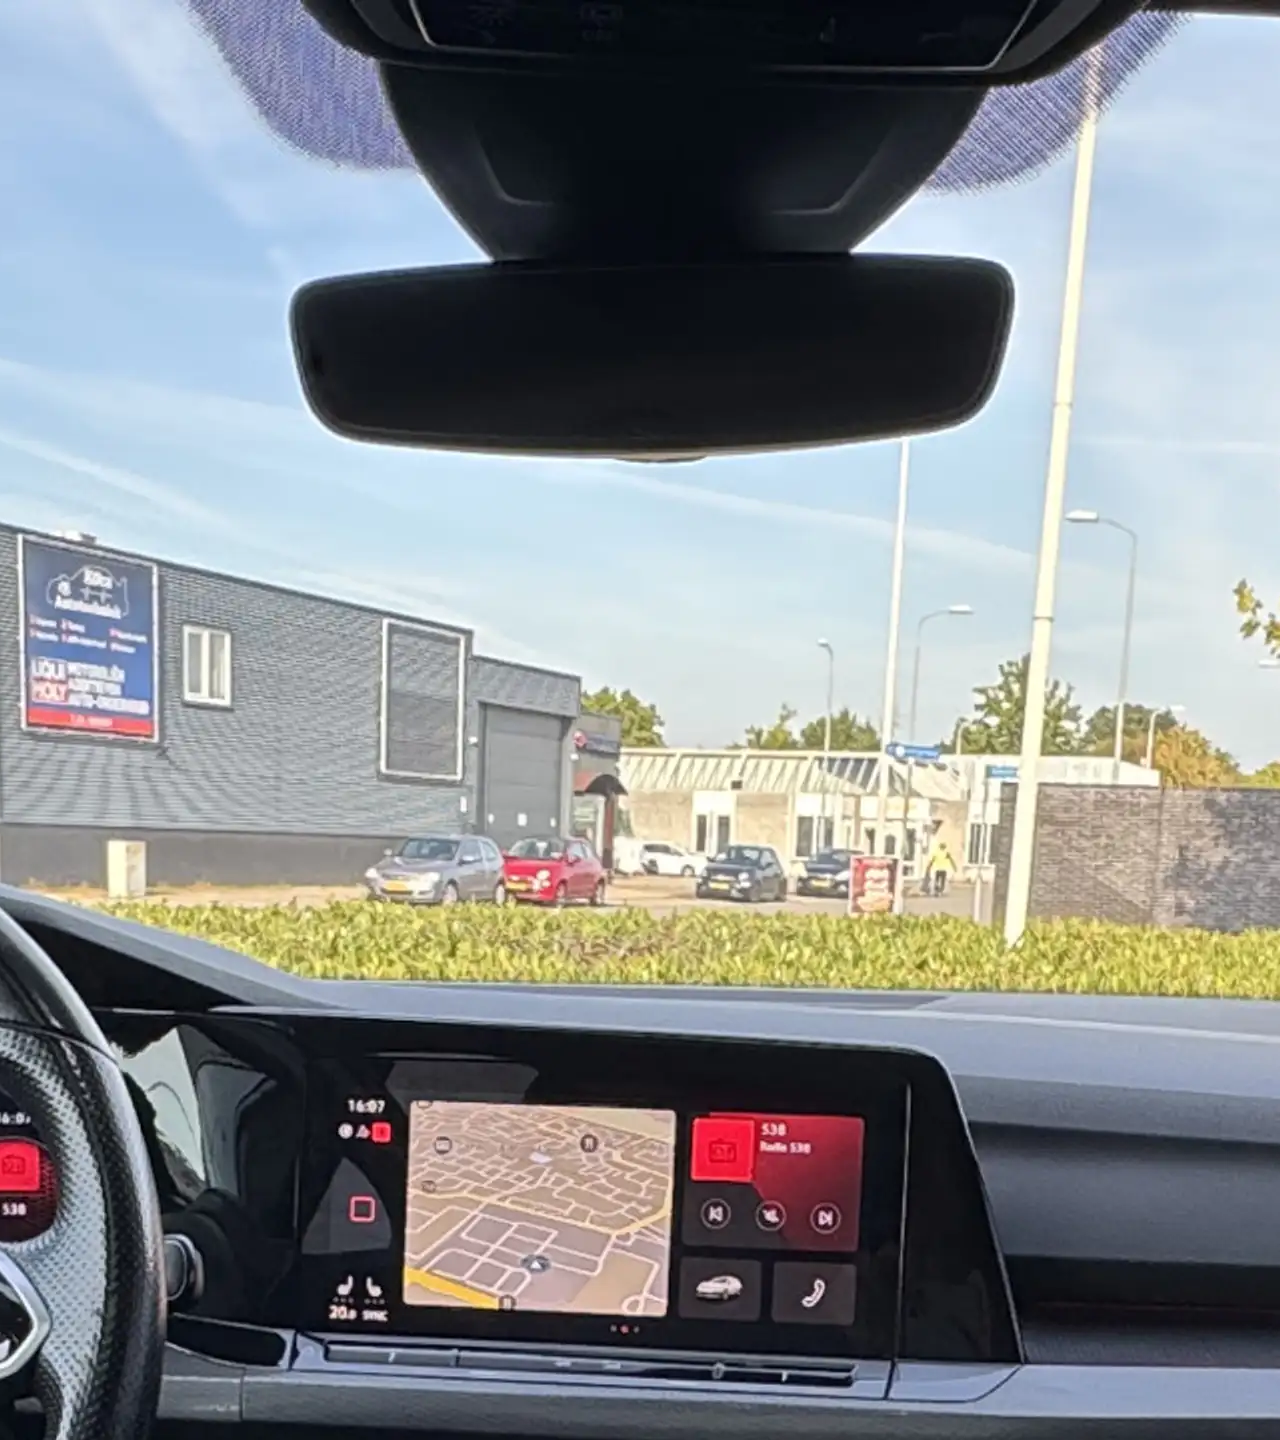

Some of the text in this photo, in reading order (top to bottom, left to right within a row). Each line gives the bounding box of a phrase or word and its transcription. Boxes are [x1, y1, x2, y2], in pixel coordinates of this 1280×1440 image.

[347, 1099, 386, 1114] 16:07
[760, 1123, 788, 1136] 538
[760, 1141, 812, 1154] Radio 538
[1, 1202, 28, 1216] 538
[361, 1309, 389, 1322] SYNC
